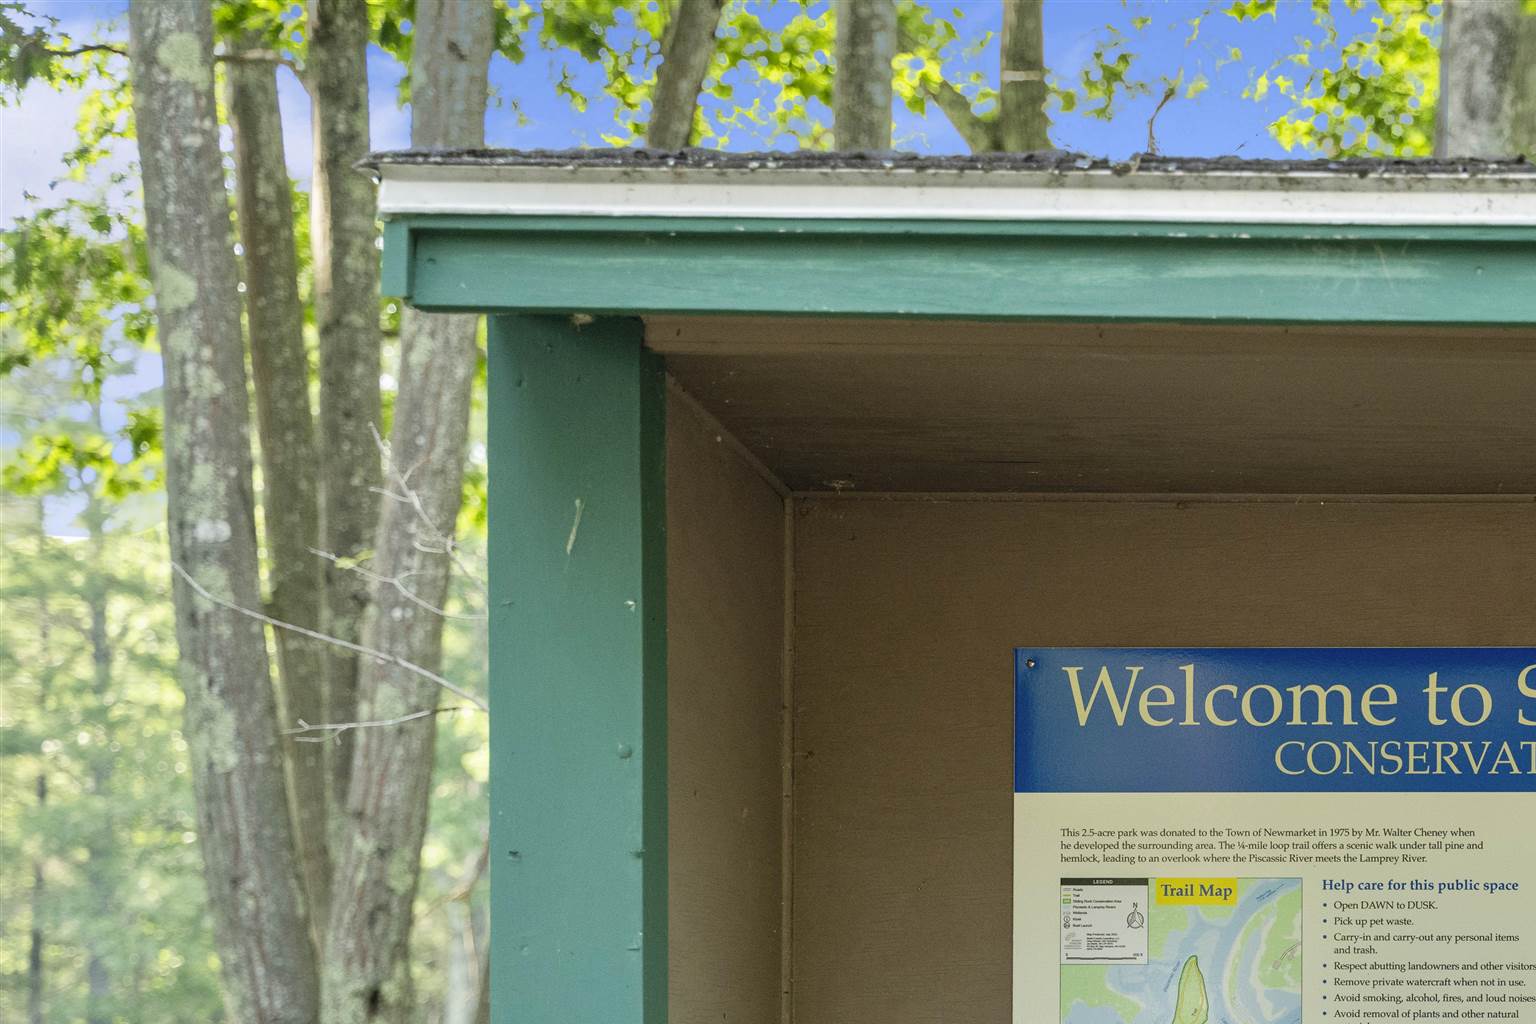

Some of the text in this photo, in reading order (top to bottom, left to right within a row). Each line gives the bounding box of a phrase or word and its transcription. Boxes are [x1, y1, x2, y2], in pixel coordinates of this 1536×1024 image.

[1062, 664, 1398, 727] Welcome
[1422, 672, 1493, 727] to
[1060, 828, 1080, 837] This
[1081, 828, 1116, 837] 2.5-acre
[1117, 828, 1138, 838] park
[1159, 828, 1196, 837] donated
[1198, 829, 1208, 837] to
[1209, 827, 1224, 837] the
[1225, 828, 1251, 837] Town
[1252, 828, 1262, 837] of
[1264, 828, 1316, 837] Newmarket
[1318, 828, 1328, 837] in
[1330, 828, 1350, 837] 1975
[1351, 828, 1363, 838] by
[1365, 828, 1380, 837] Mr.
[1383, 828, 1412, 837] Walter
[1413, 827, 1448, 838] Cheney
[1450, 827, 1475, 837] when
[1159, 882, 1194, 901] Trail
[1196, 882, 1233, 901] Map
[1322, 879, 1519, 894] Help care for this public space
[1333, 901, 1359, 911] Open
[1361, 901, 1394, 909] DAWN
[1407, 901, 1438, 910] DUSK.
[1334, 917, 1353, 925] Pick
[1355, 919, 1368, 927] up
[1369, 918, 1384, 927] pet
